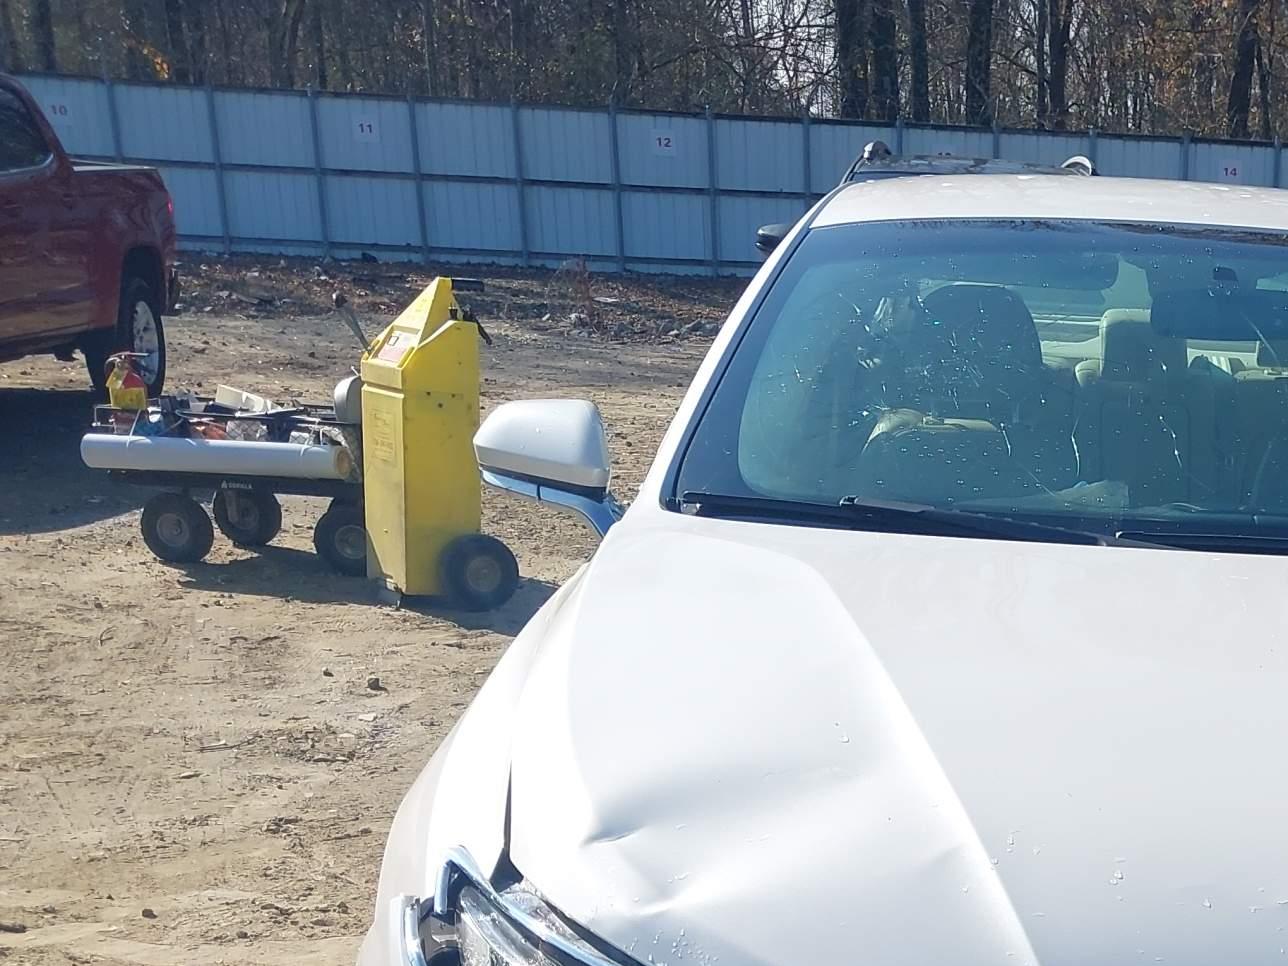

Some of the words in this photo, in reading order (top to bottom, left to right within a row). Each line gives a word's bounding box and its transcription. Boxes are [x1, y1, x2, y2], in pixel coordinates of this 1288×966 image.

[50, 104, 68, 116] 10
[358, 122, 373, 134] 11
[655, 136, 672, 148] 12
[1223, 166, 1238, 177] 14
